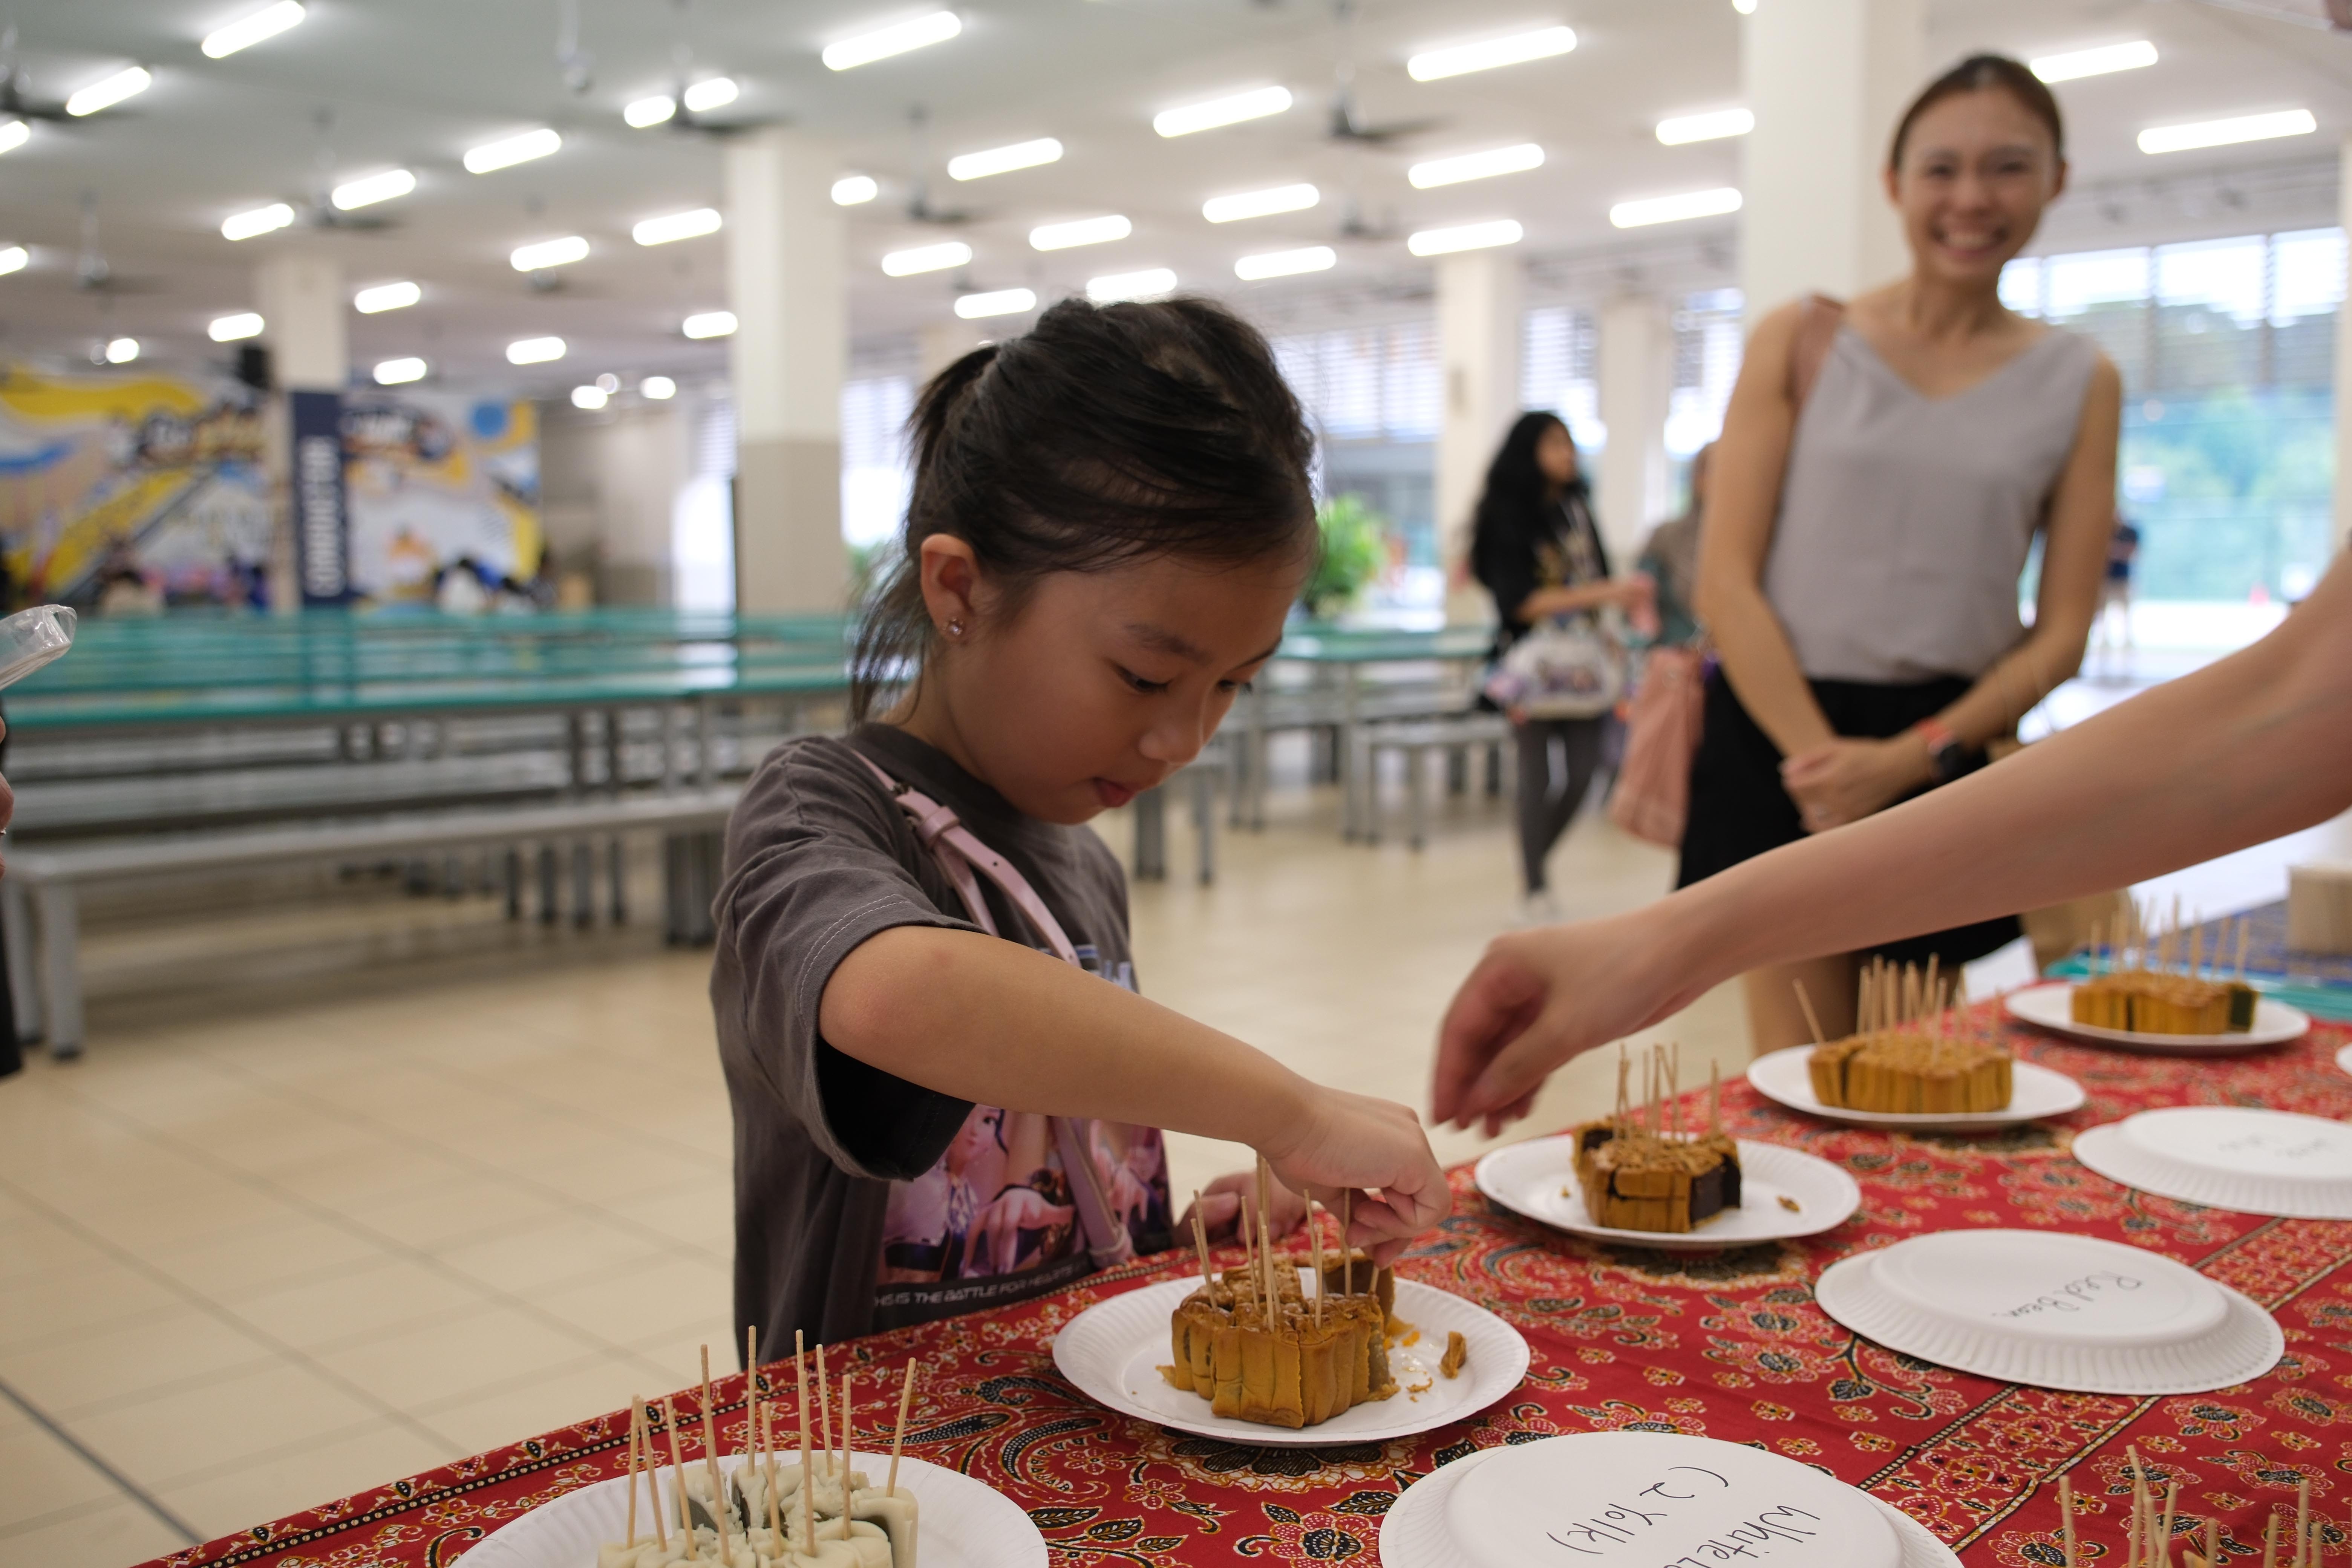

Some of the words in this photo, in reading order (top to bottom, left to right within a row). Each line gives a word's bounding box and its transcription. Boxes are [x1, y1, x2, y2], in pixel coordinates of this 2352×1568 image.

[874, 1294, 893, 1307] HIS
[914, 1291, 943, 1304] THE
[944, 1285, 998, 1302] BATTLE
[999, 1278, 1026, 1295] FOR
[2053, 1270, 2143, 1302] Red
[1546, 1503, 1668, 1554] Yolk)
[1697, 1505, 1821, 1558] White
